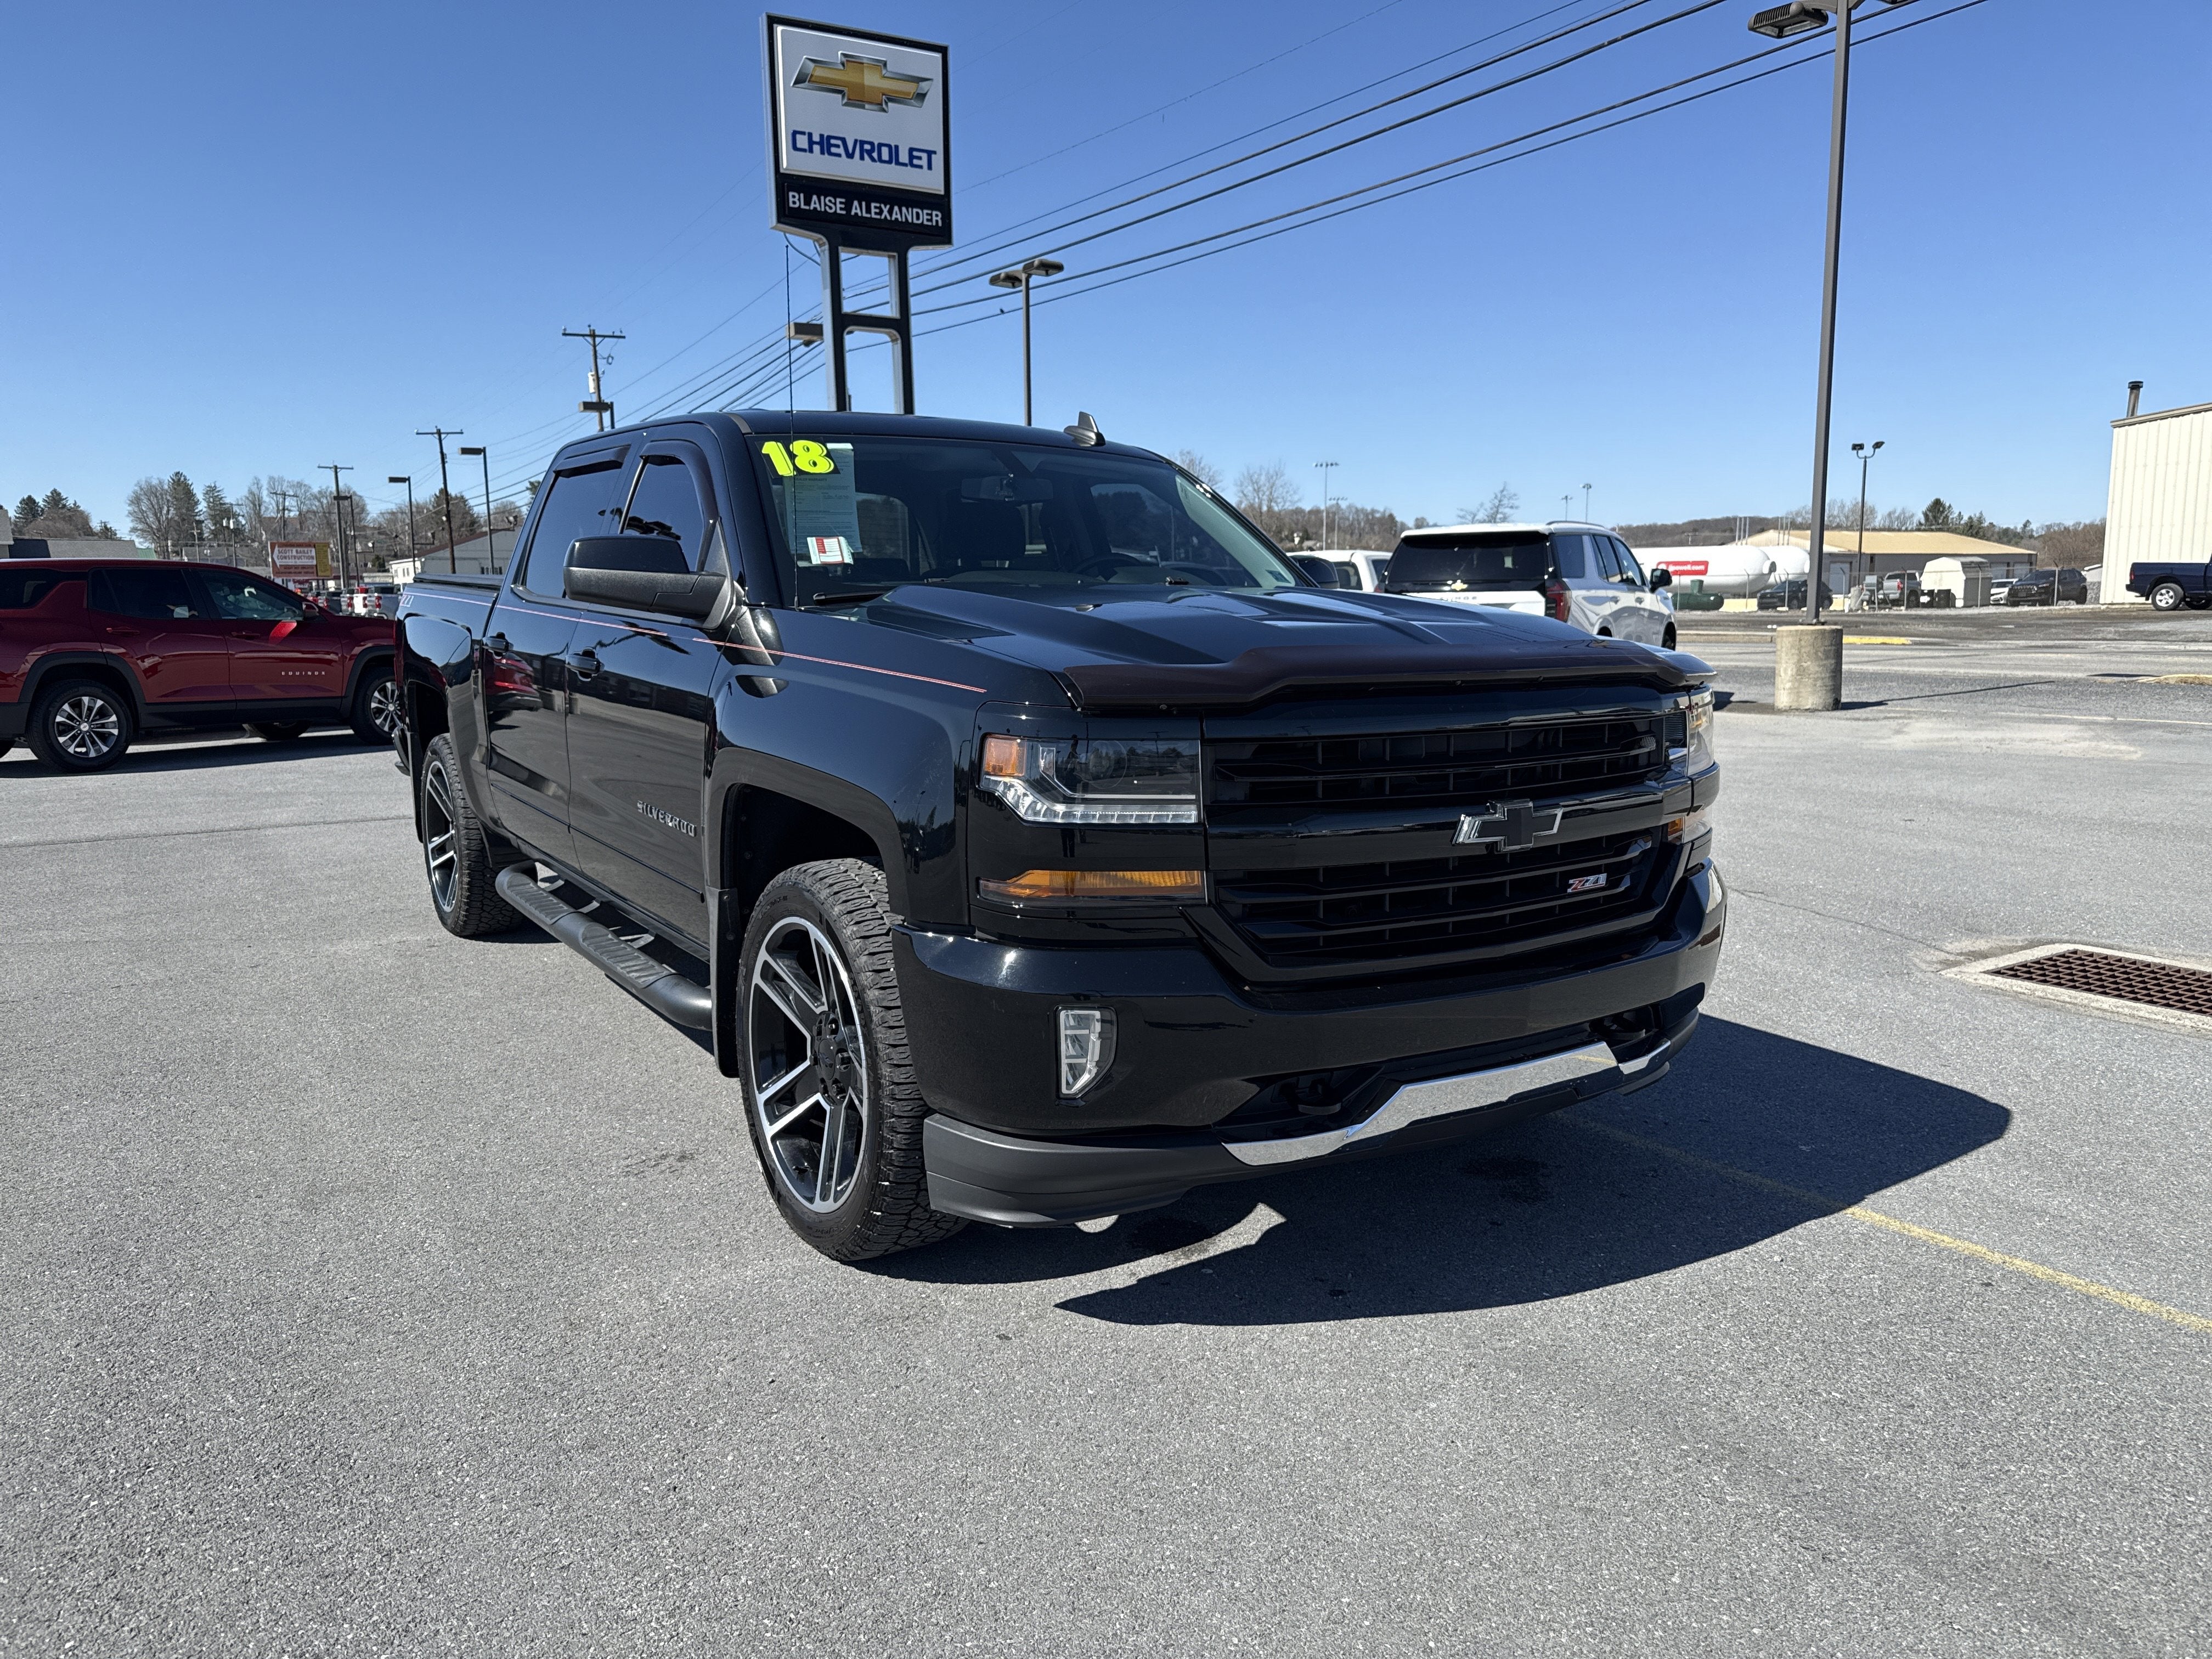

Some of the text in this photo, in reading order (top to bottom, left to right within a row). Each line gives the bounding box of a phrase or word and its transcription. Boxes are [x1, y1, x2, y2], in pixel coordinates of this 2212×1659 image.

[791, 130, 936, 171] CHEVROLET
[788, 191, 943, 227] BLAISE ALEXANDER
[761, 440, 834, 476] 18
[637, 800, 696, 837] SILVERADO
[1567, 873, 1607, 893] Z71
